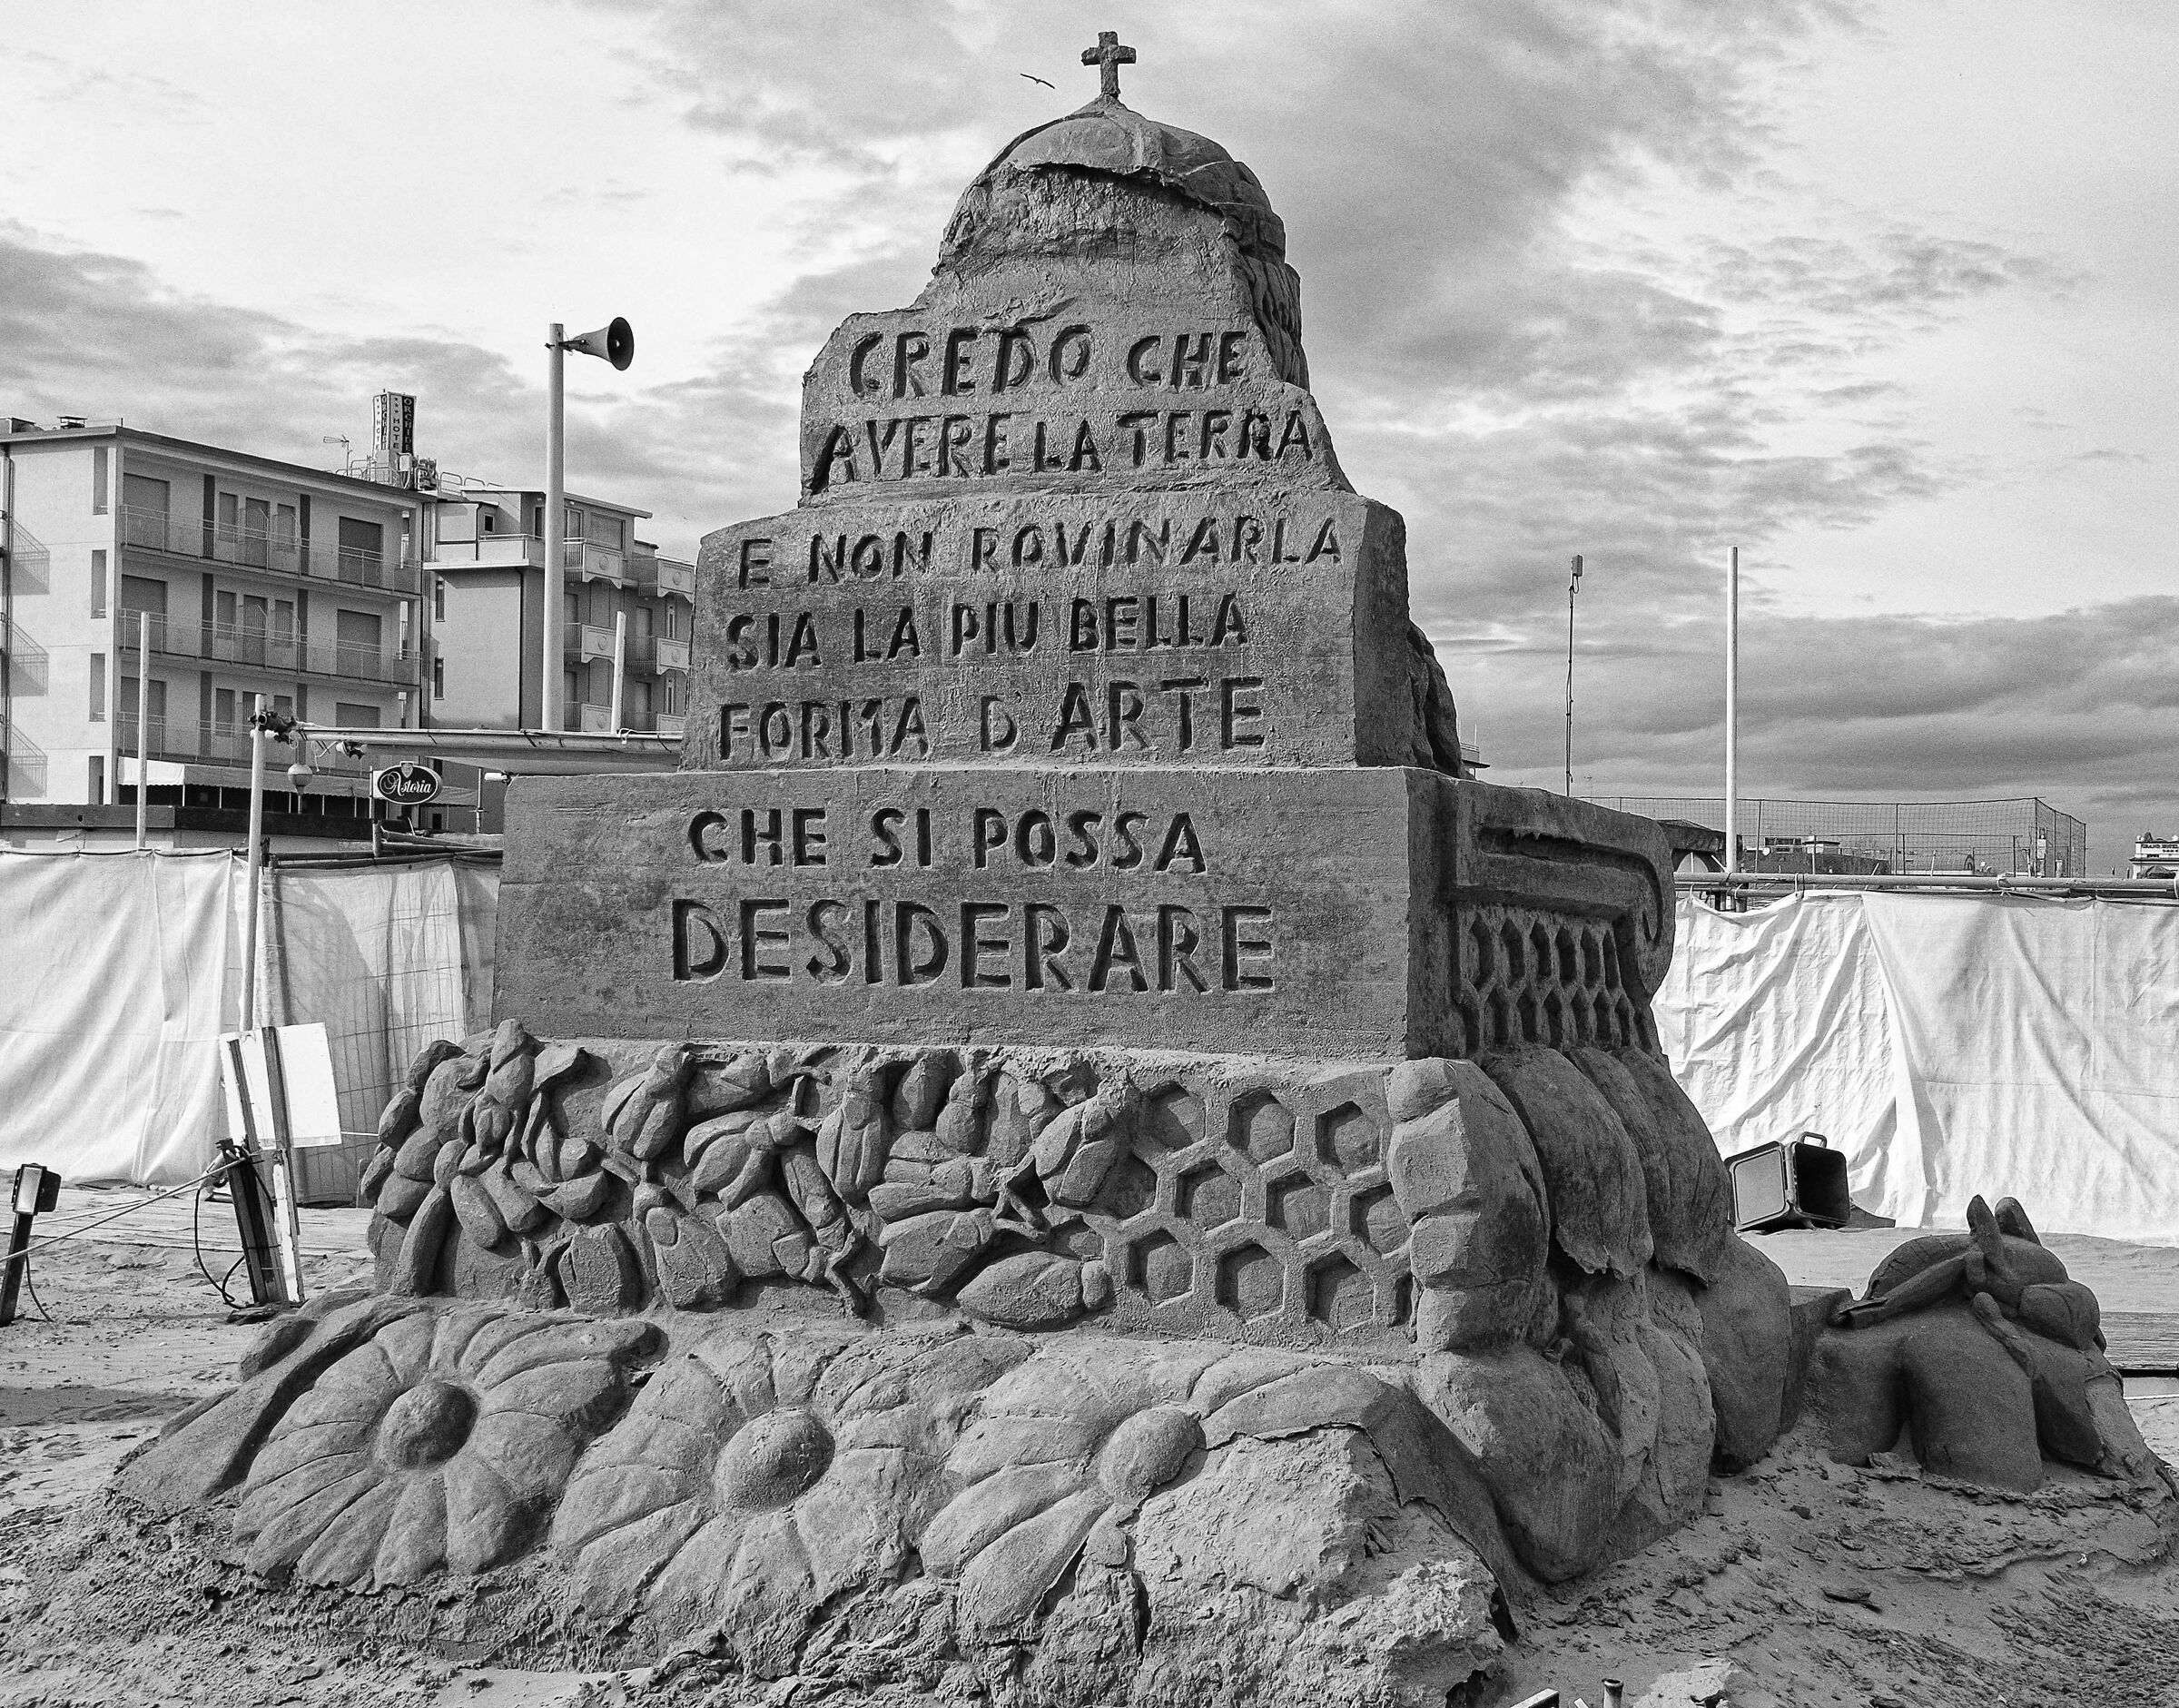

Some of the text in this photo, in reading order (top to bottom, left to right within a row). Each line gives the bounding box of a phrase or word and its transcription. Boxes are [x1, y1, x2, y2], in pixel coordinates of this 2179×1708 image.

[849, 324, 1249, 399] CREDO CHE
[811, 408, 1314, 495] AVERE LA TERRA
[738, 515, 1342, 591] E NON ROVINARLA
[726, 610, 823, 673] SIA
[853, 606, 921, 664] LA
[1070, 592, 1248, 654] BELLA
[719, 696, 932, 761] FORMA
[380, 771, 432, 796] Astoria
[685, 806, 1208, 874] CHE SI POSSA
[671, 898, 1276, 993] DESIDERARE
